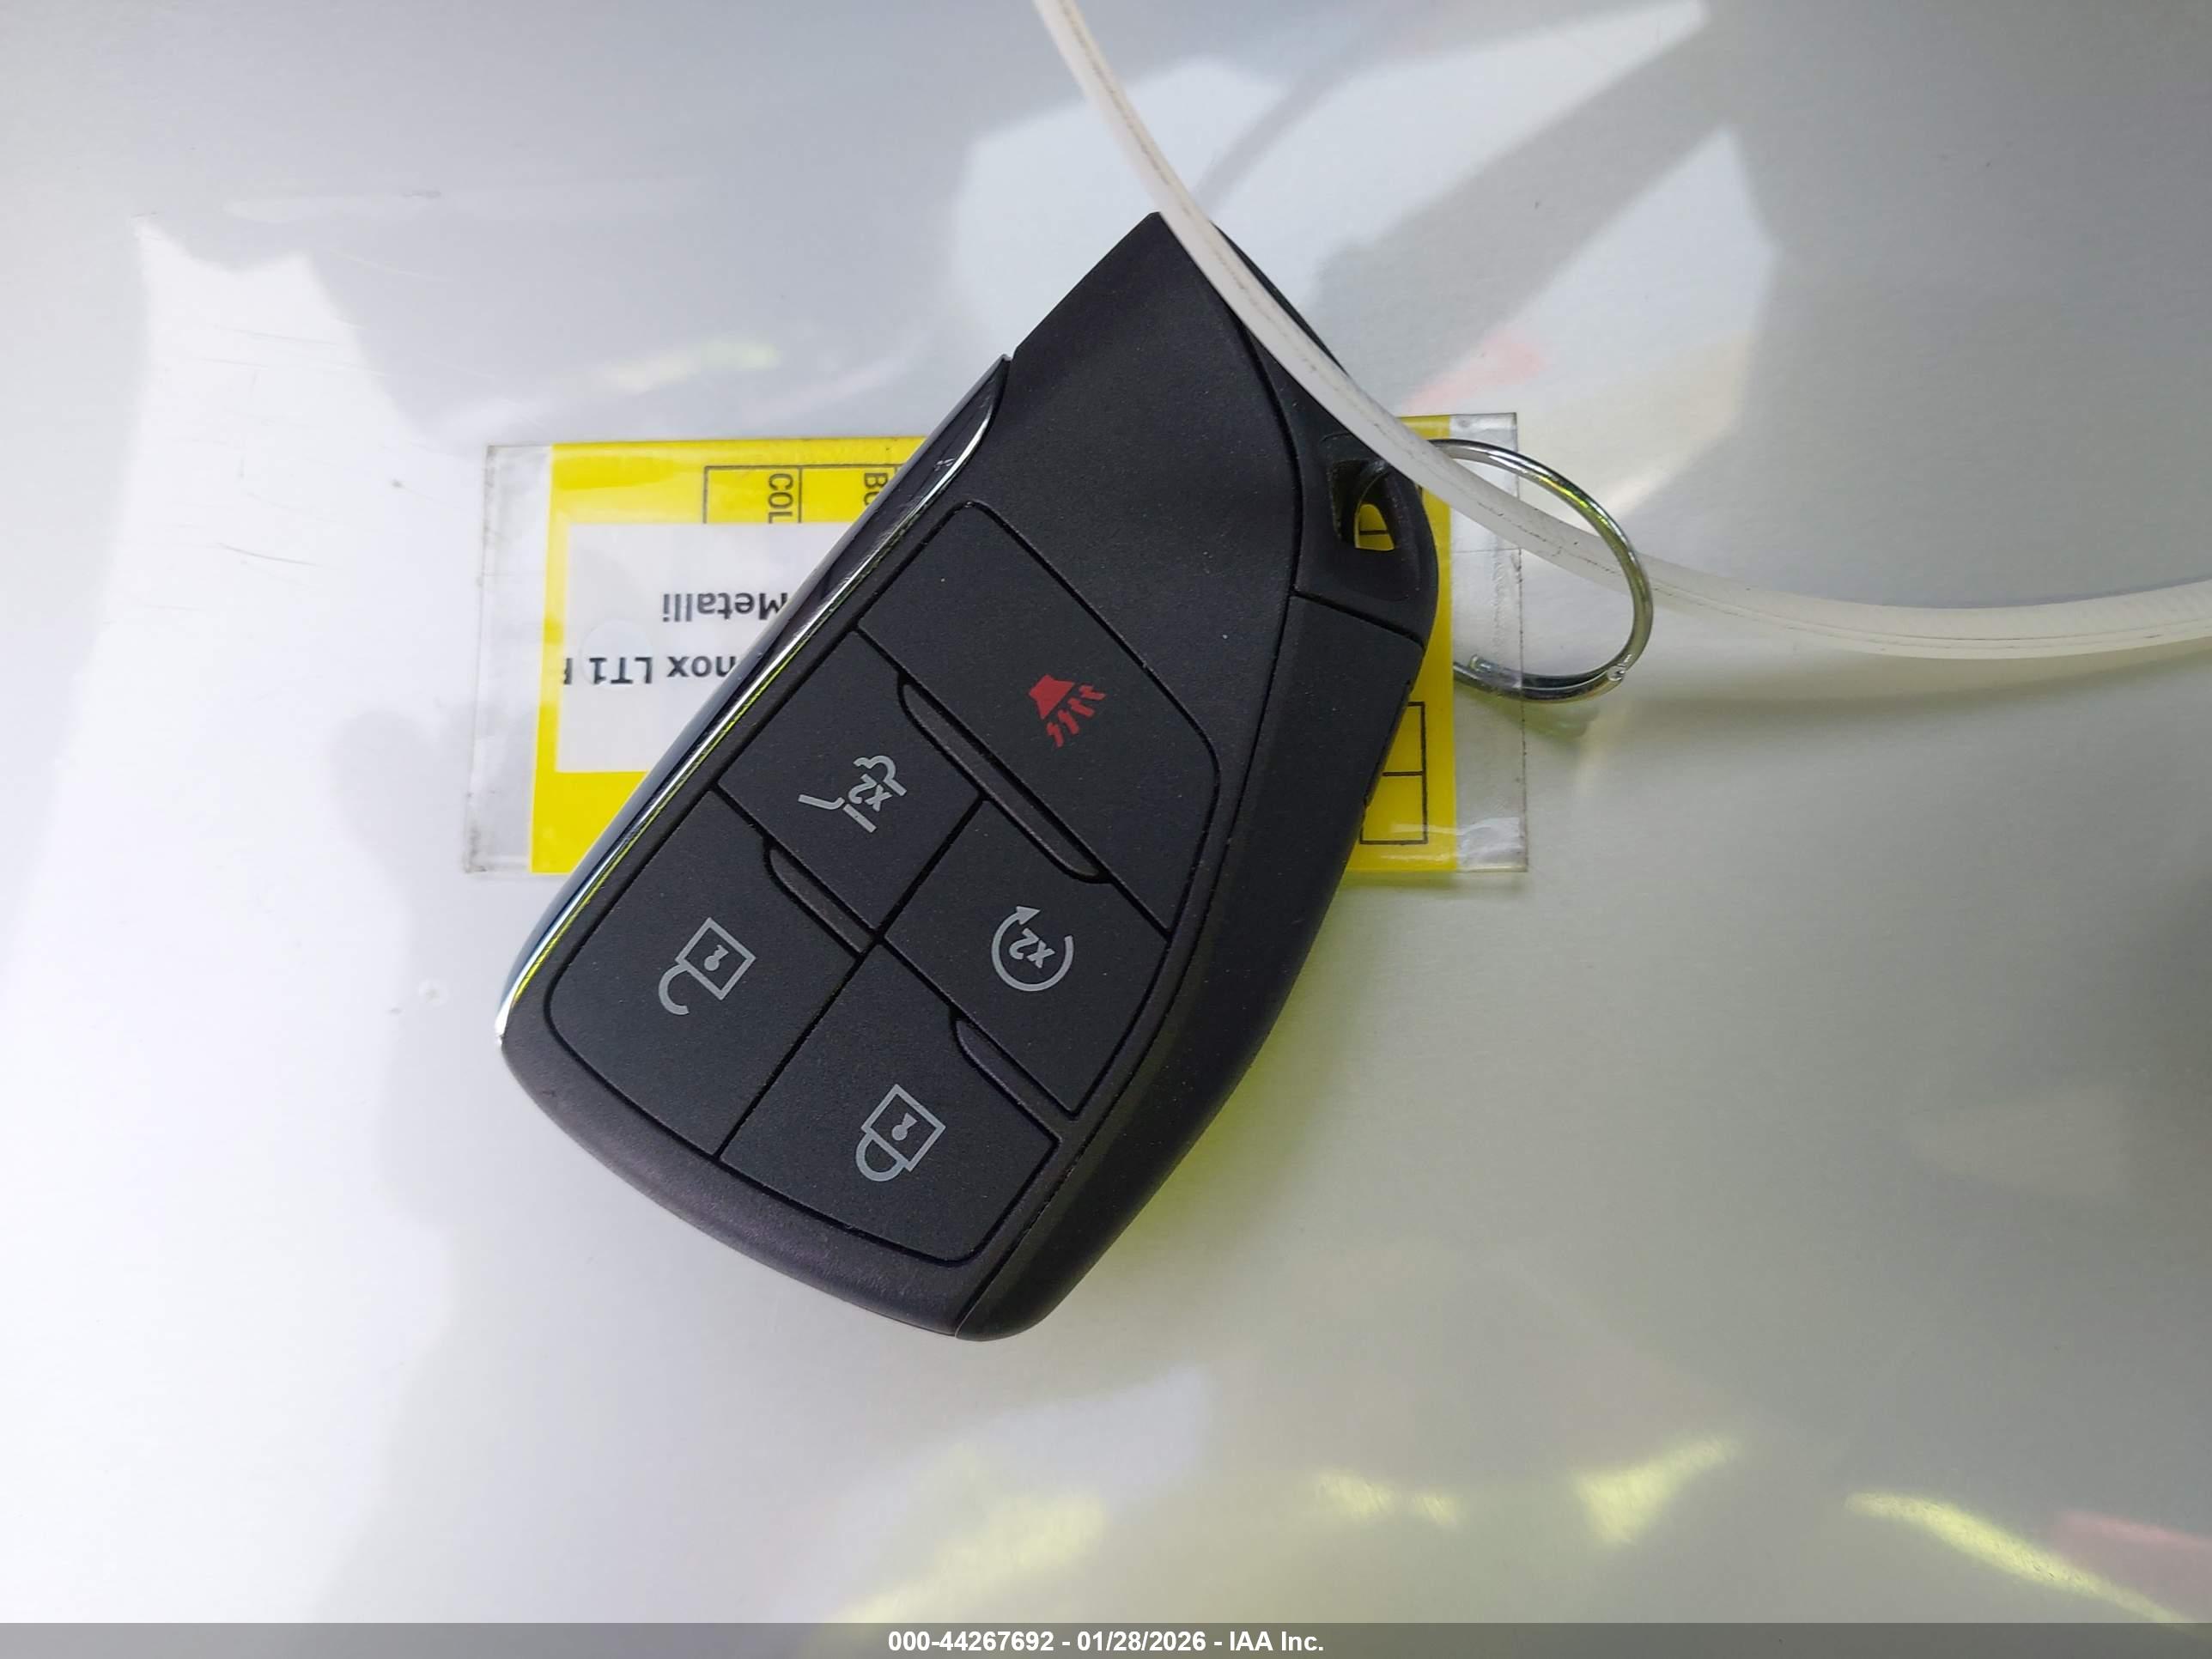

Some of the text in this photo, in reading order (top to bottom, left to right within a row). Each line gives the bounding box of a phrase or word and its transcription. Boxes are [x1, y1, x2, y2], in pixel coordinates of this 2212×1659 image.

[768, 473, 793, 524] COL
[662, 592, 787, 622] Metalli
[589, 656, 653, 684] LT1
